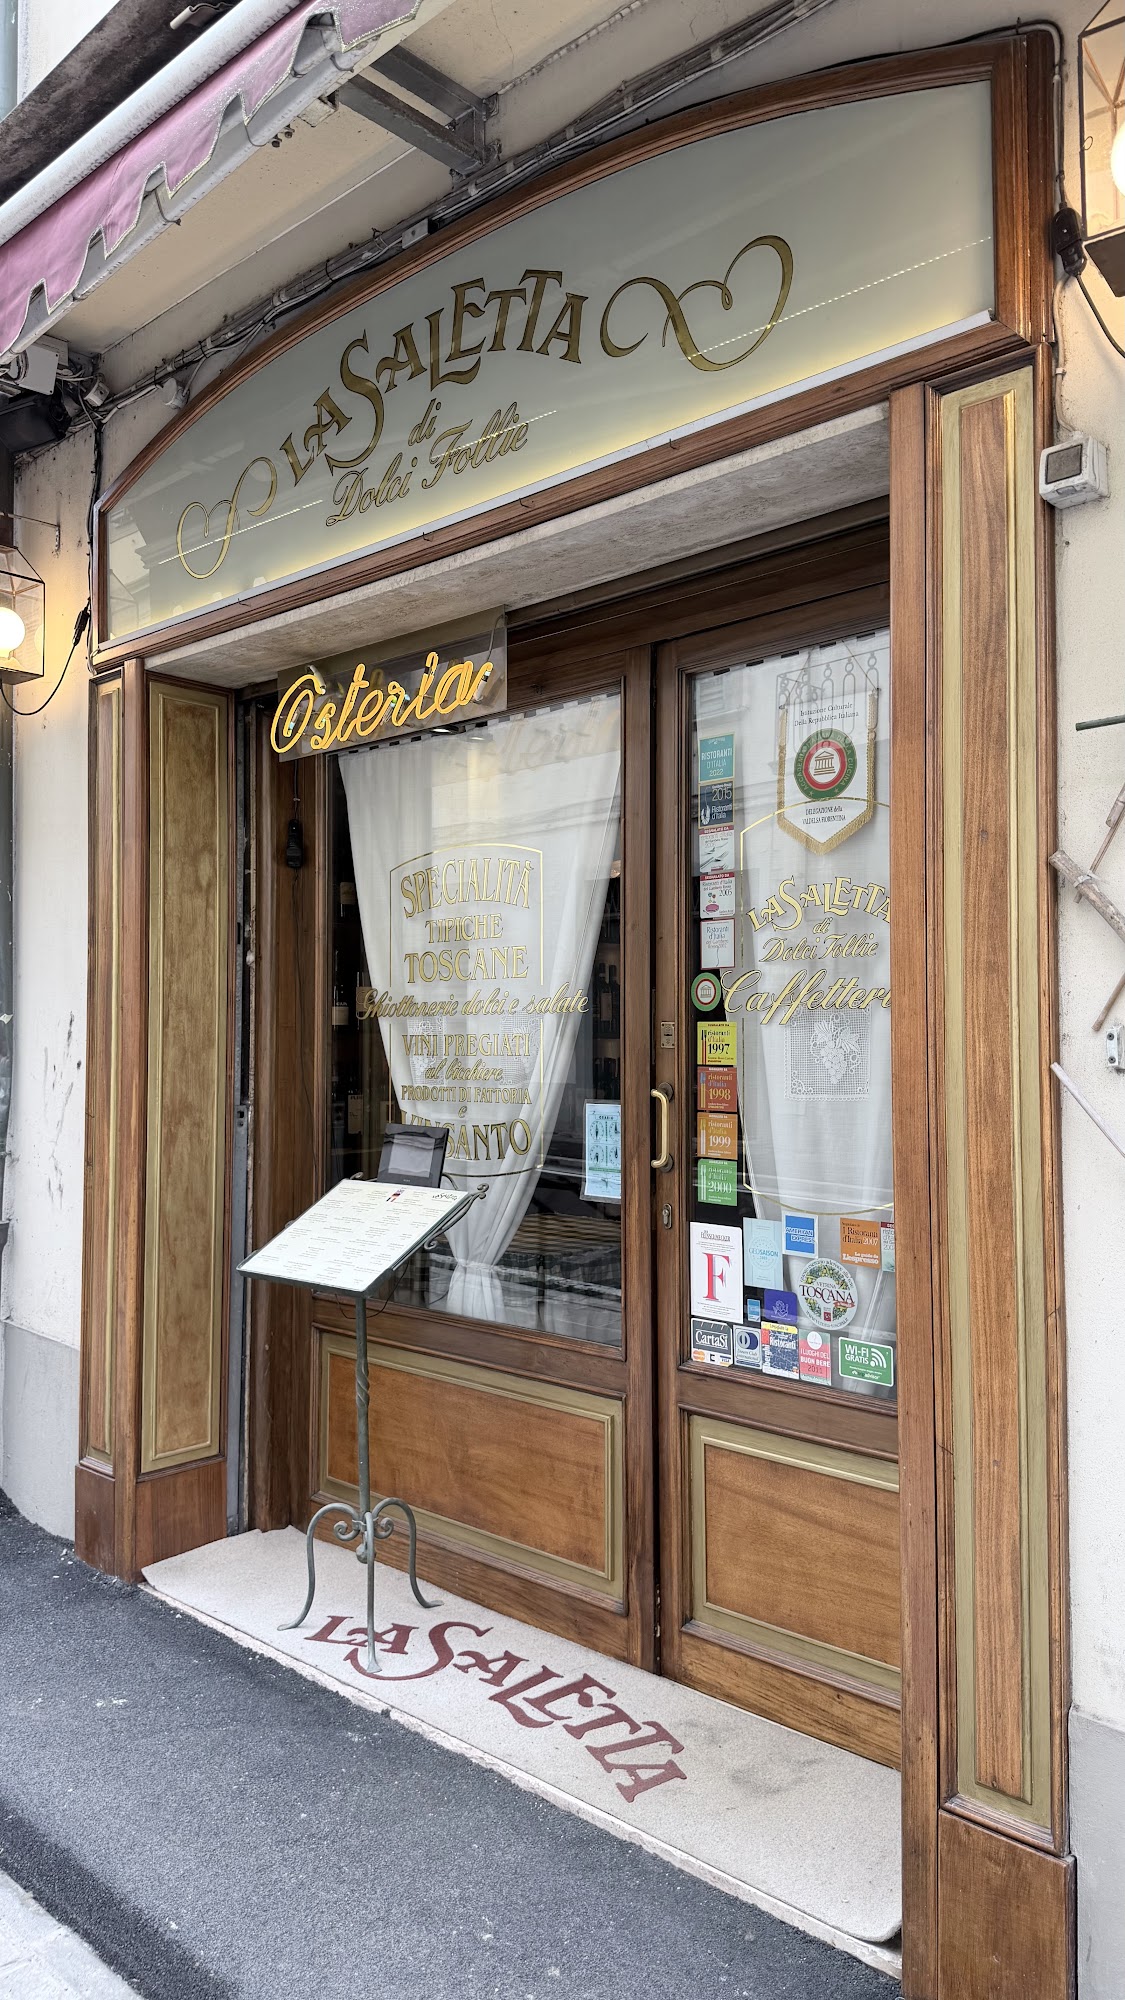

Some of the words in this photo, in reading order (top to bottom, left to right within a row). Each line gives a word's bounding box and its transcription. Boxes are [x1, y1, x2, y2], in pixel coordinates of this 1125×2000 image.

[281, 386, 351, 487] LA
[324, 269, 589, 476] SALETTA
[408, 398, 442, 445] di
[326, 455, 418, 527] Dolci
[422, 401, 530, 489] Follie
[270, 651, 494, 753] Osteria
[701, 747, 733, 760] RISTORANTI
[709, 768, 724, 777] 2022
[712, 786, 732, 801] 2015
[711, 803, 733, 813] Ristoranti
[400, 857, 532, 919] SPECIALITÀ
[746, 899, 787, 932] LA
[773, 875, 890, 932] SALETTA
[424, 913, 503, 944] TIPICHE
[813, 917, 833, 934] di
[759, 937, 819, 963] Dolci
[818, 933, 880, 960] Follie
[403, 945, 529, 984] TOSCANE
[356, 988, 459, 1020] Ghiottonerie
[461, 987, 508, 1016] dolci
[508, 998, 520, 1016] e
[522, 981, 590, 1015] salate
[401, 1034, 439, 1057] VINI
[444, 1033, 531, 1057] PREGIATI
[708, 1043, 730, 1055] 1997
[424, 1058, 447, 1081] al
[444, 1058, 504, 1082] bicchiere
[401, 1085, 457, 1103] PRODOTTI
[459, 1086, 471, 1103] DI
[474, 1087, 533, 1105] FATTORIA
[708, 1087, 732, 1101] 1998
[457, 1105, 468, 1119] e
[708, 1135, 731, 1148] 1999
[708, 1180, 732, 1194] 2000
[847, 1226, 878, 1238] Ristoranti
[701, 1252, 731, 1302] F
[799, 1284, 855, 1304] TOSCANA
[803, 1348, 819, 1357] LUOGHI
[845, 1343, 869, 1358] WI-FI
[845, 1353, 869, 1364] GRATIS
[800, 1356, 815, 1364] BUON
[816, 1359, 831, 1367] BERE
[807, 1364, 823, 1374] 2011
[304, 1614, 419, 1655] LA
[343, 1620, 688, 1804] SALETTA
